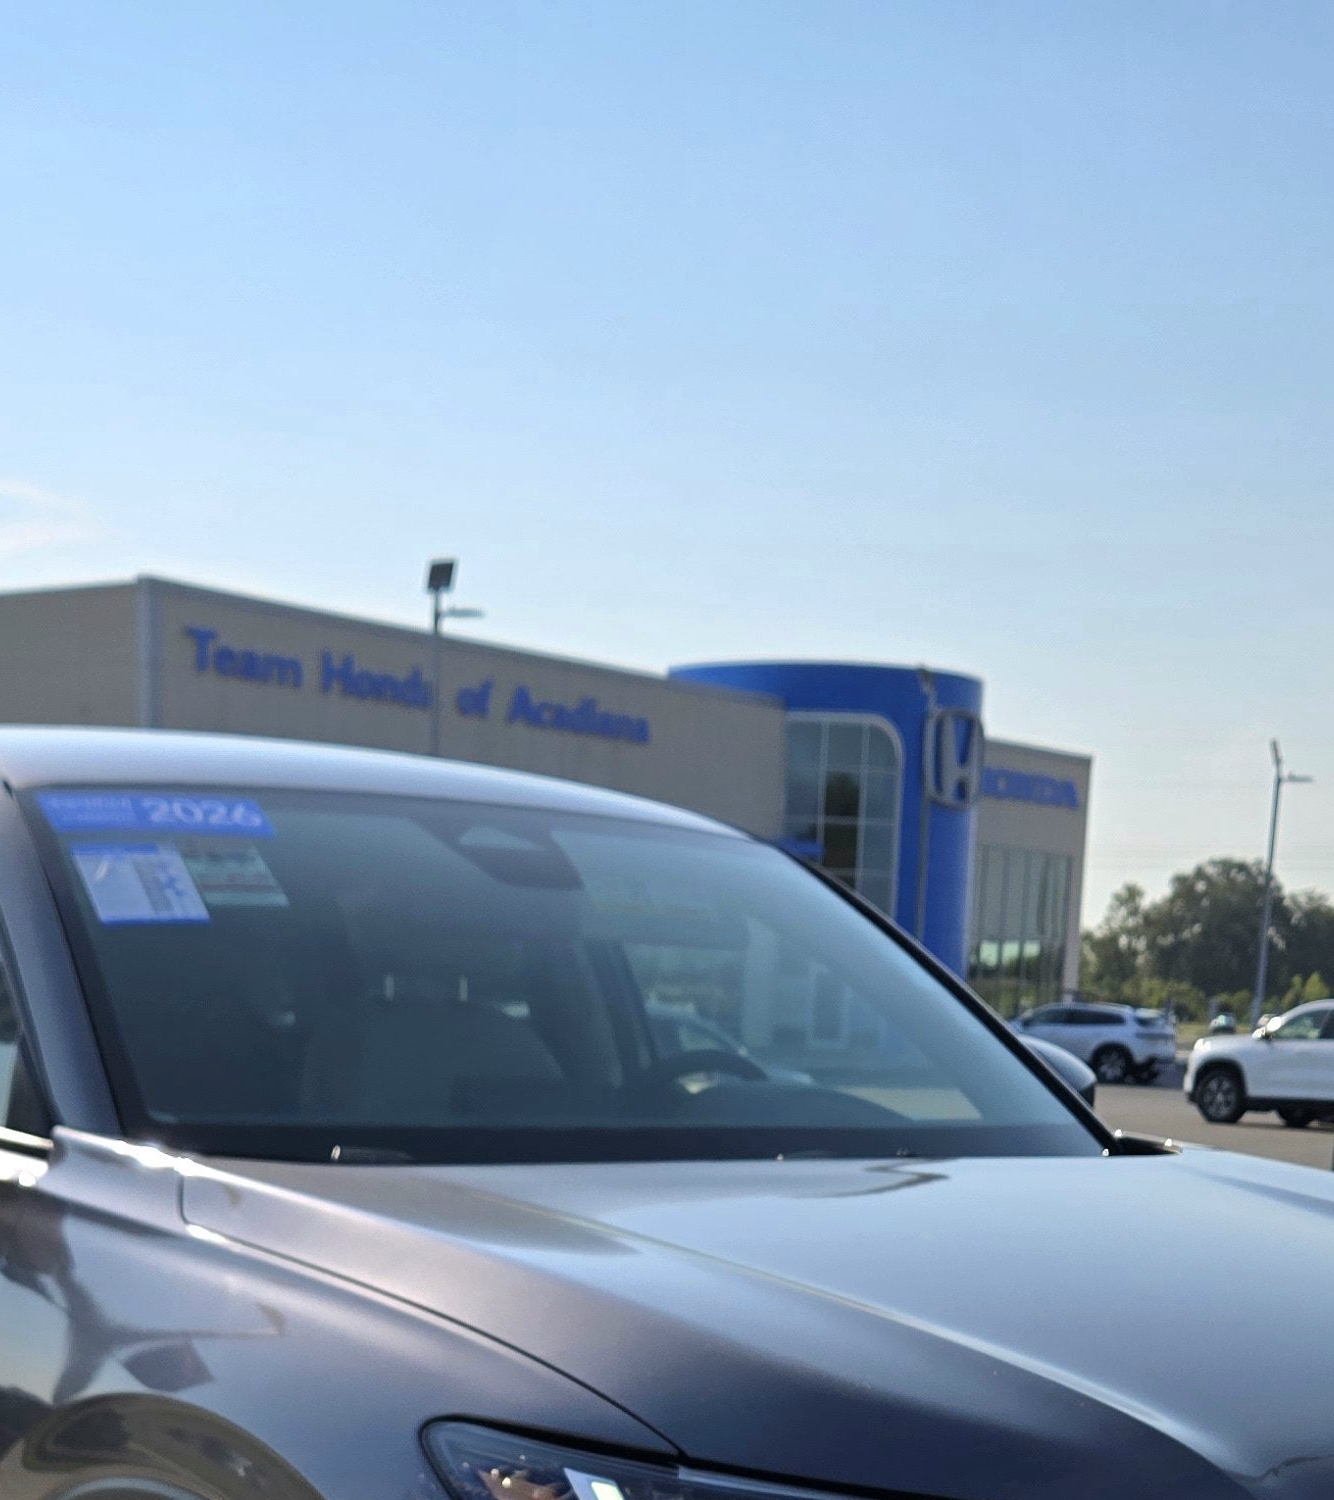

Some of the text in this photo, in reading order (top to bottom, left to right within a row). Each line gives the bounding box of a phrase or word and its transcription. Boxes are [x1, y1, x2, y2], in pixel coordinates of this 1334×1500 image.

[185, 624, 303, 689] Team
[318, 647, 433, 710] Honda
[456, 676, 495, 716] of
[142, 797, 263, 827] 2026
